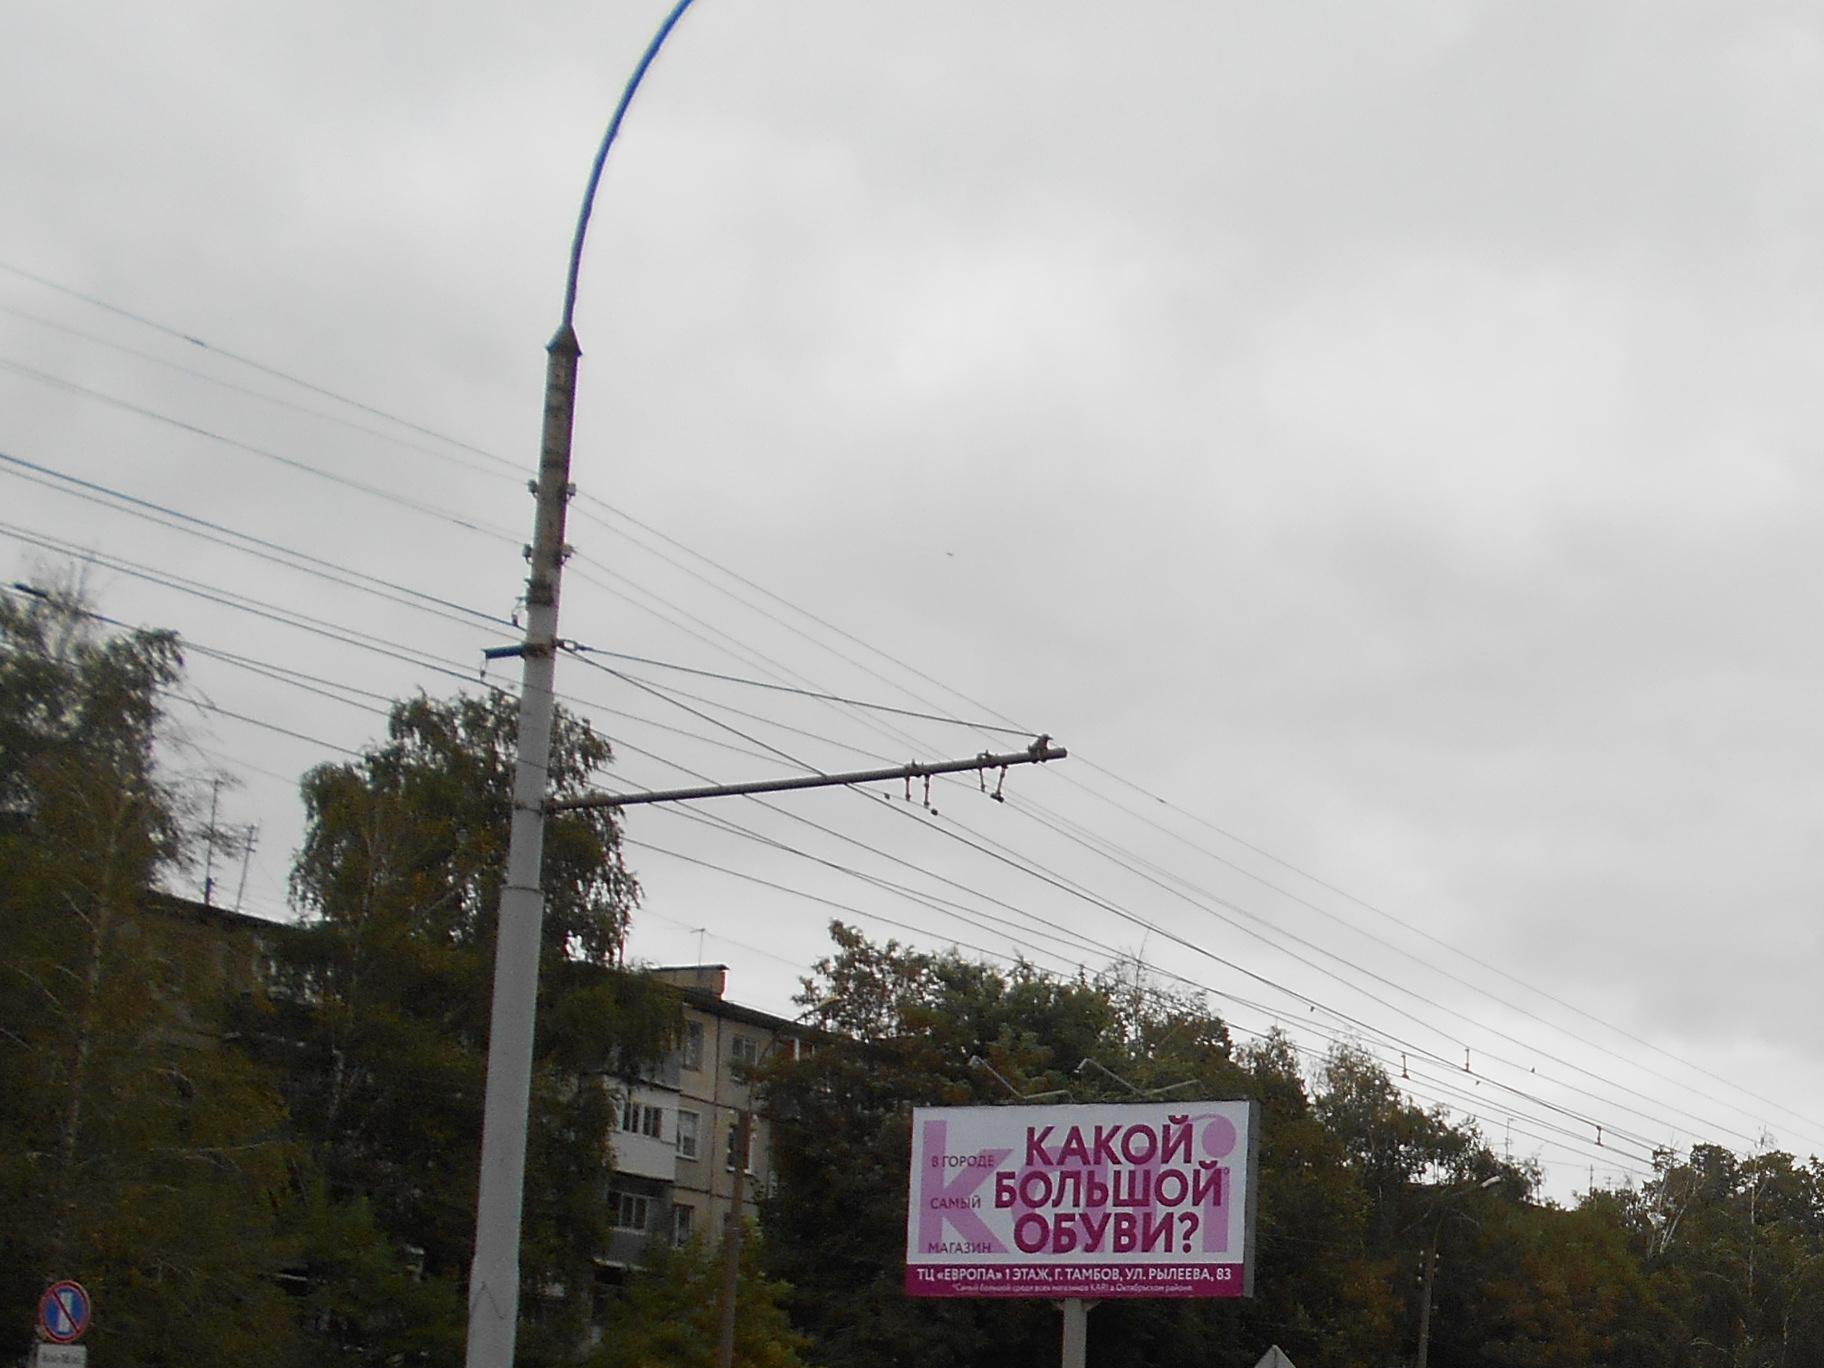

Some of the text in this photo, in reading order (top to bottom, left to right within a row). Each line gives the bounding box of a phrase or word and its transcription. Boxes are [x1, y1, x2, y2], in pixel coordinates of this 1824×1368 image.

[1026, 1114, 1194, 1167] КАКОЙ
[931, 1155, 995, 1168] В ГОРОДЕ
[994, 1160, 1223, 1209] БОЛЬШОЙ
[930, 1195, 982, 1210] САМЫЙ
[1013, 1211, 1200, 1254] ОБУВИ?
[928, 1242, 992, 1254] МАГАЗИН
[917, 1268, 935, 1282] ТЦ
[937, 1268, 1002, 1281] «ЕВРОПА»
[1012, 1268, 1053, 1282] ЭТАЖ,
[1054, 1268, 1064, 1281] Г.
[1065, 1268, 1124, 1282] ТАМБОВ,
[1126, 1268, 1147, 1281] УЛ.
[1149, 1268, 1214, 1282] РЫЛЕЕВА,
[1216, 1268, 1232, 1281] 83
